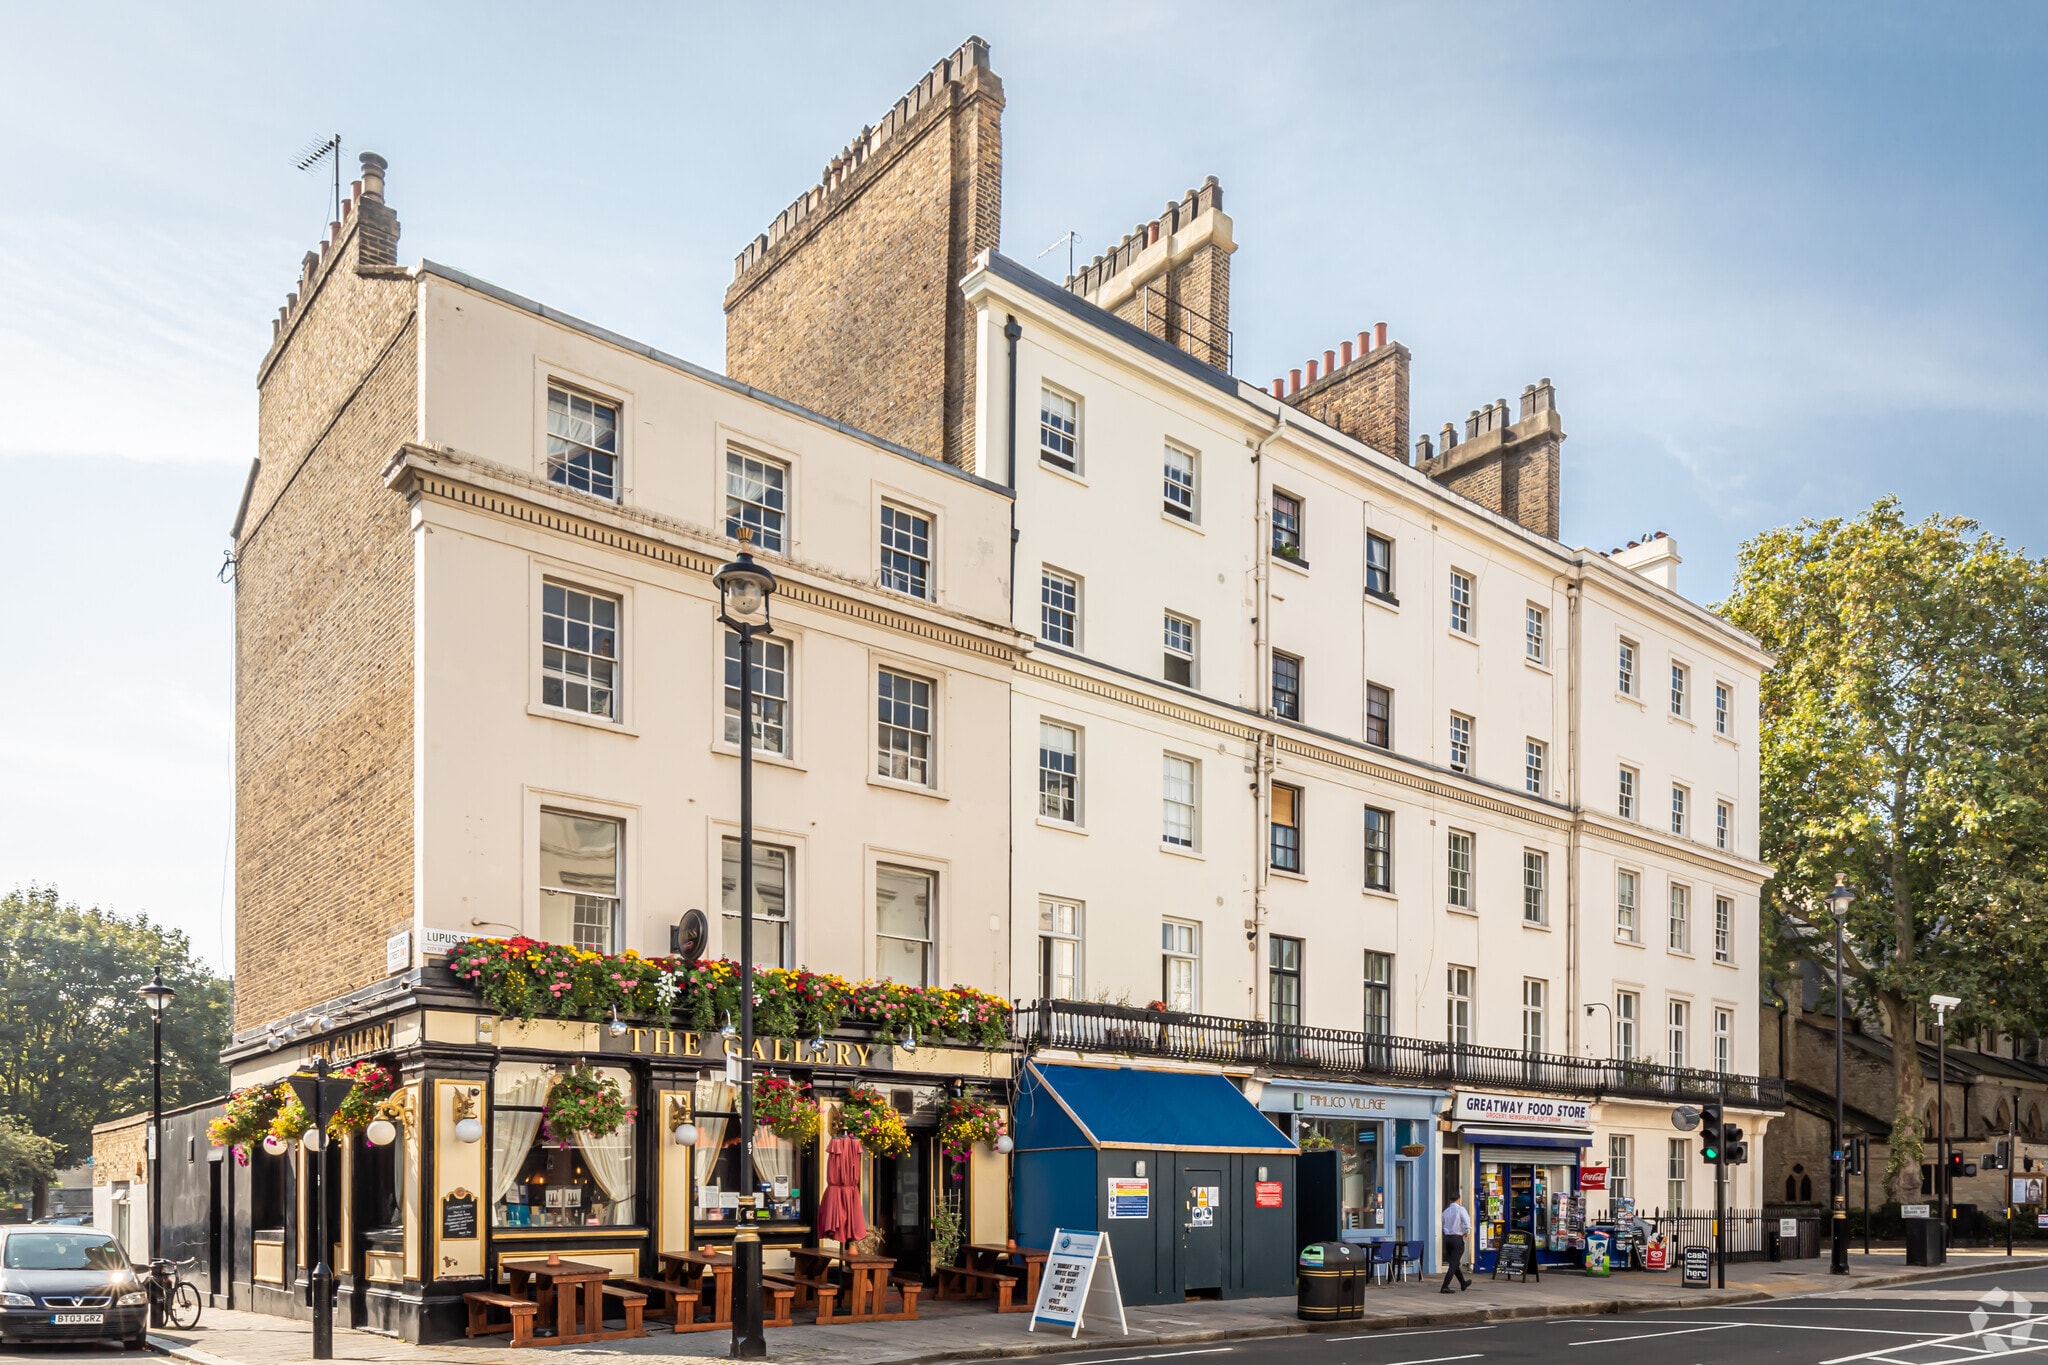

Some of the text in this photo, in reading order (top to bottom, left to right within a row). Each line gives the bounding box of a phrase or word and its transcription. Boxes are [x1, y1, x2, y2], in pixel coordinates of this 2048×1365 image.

[427, 932, 458, 944] LUPUS
[308, 1020, 394, 1065] THE GALLERY
[627, 1028, 870, 1067] THE GALLERY
[1310, 1095, 1386, 1110] PIMLICO VILLAGE
[1466, 1097, 1586, 1118] GREATWAY FOOD STORE
[1687, 1251, 1707, 1259] cash
[1687, 1269, 1707, 1277] here
[57, 1314, 101, 1322] BT03 GRZ
